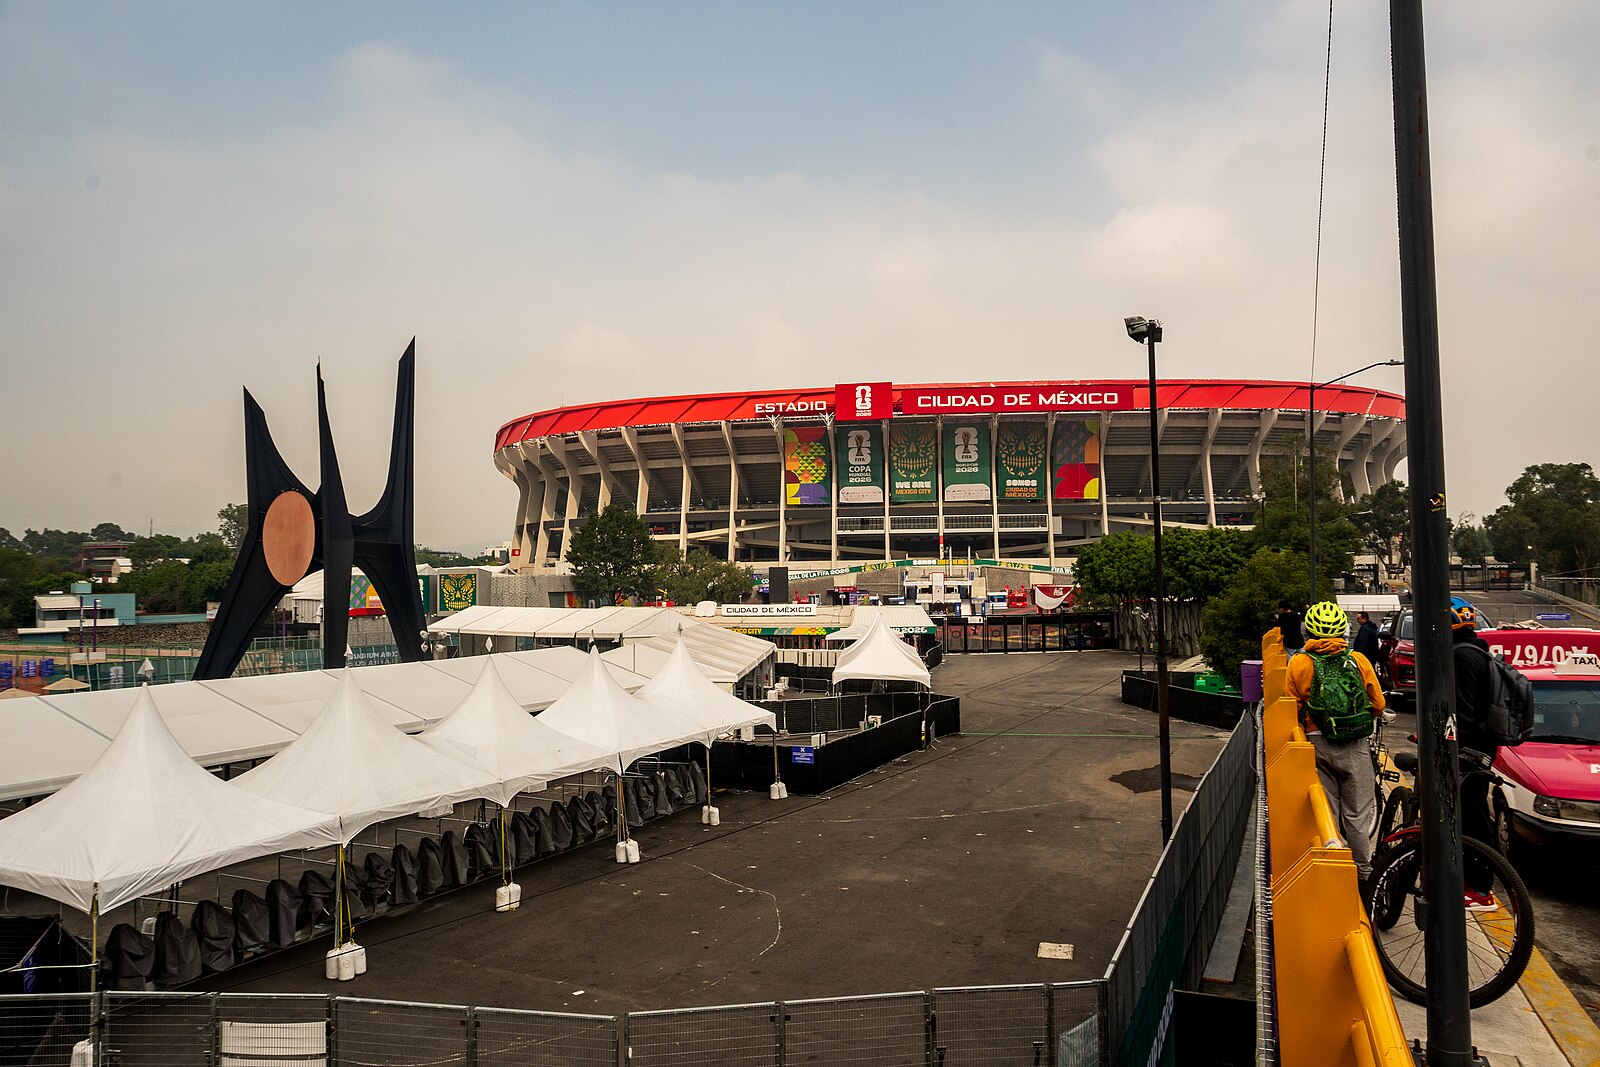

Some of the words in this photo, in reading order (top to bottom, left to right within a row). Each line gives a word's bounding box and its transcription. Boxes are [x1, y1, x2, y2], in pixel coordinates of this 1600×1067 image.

[755, 400, 827, 413] ESTADIO
[917, 394, 995, 408] CIUDAD
[1003, 393, 1032, 406] DE
[1038, 390, 1119, 406] MÉXICO
[848, 465, 872, 473] COPA
[895, 481, 911, 489] WE
[911, 480, 932, 488] ARE
[1005, 479, 1038, 487] SOMOS
[830, 567, 850, 575] 2026
[776, 605, 812, 613] MÉXICO
[747, 627, 762, 635] CITY
[1571, 656, 1598, 666] TAXI
